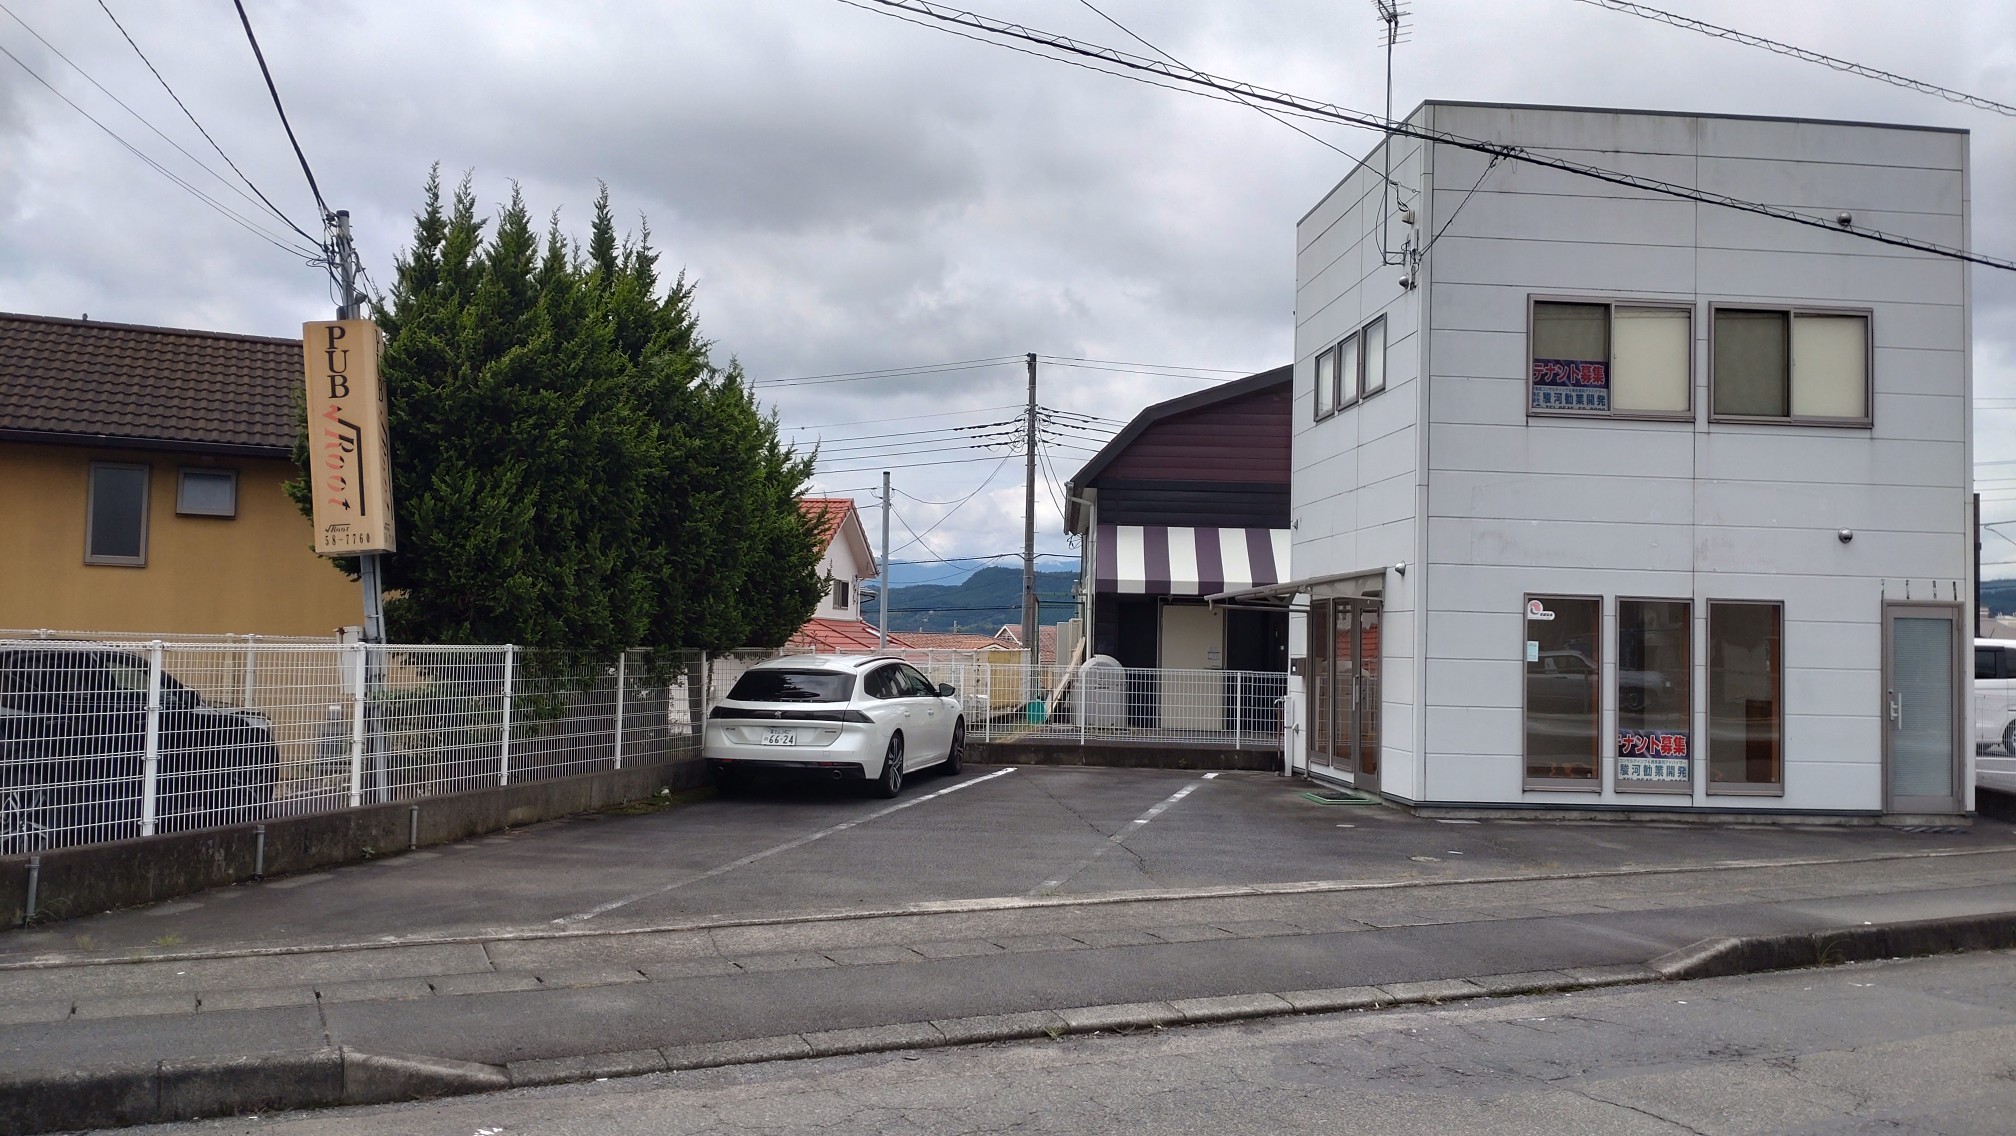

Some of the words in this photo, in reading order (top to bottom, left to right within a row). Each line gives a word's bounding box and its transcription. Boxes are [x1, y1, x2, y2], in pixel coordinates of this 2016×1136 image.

[325, 325, 350, 399] PUB
[1533, 363, 1605, 385] テナント募集
